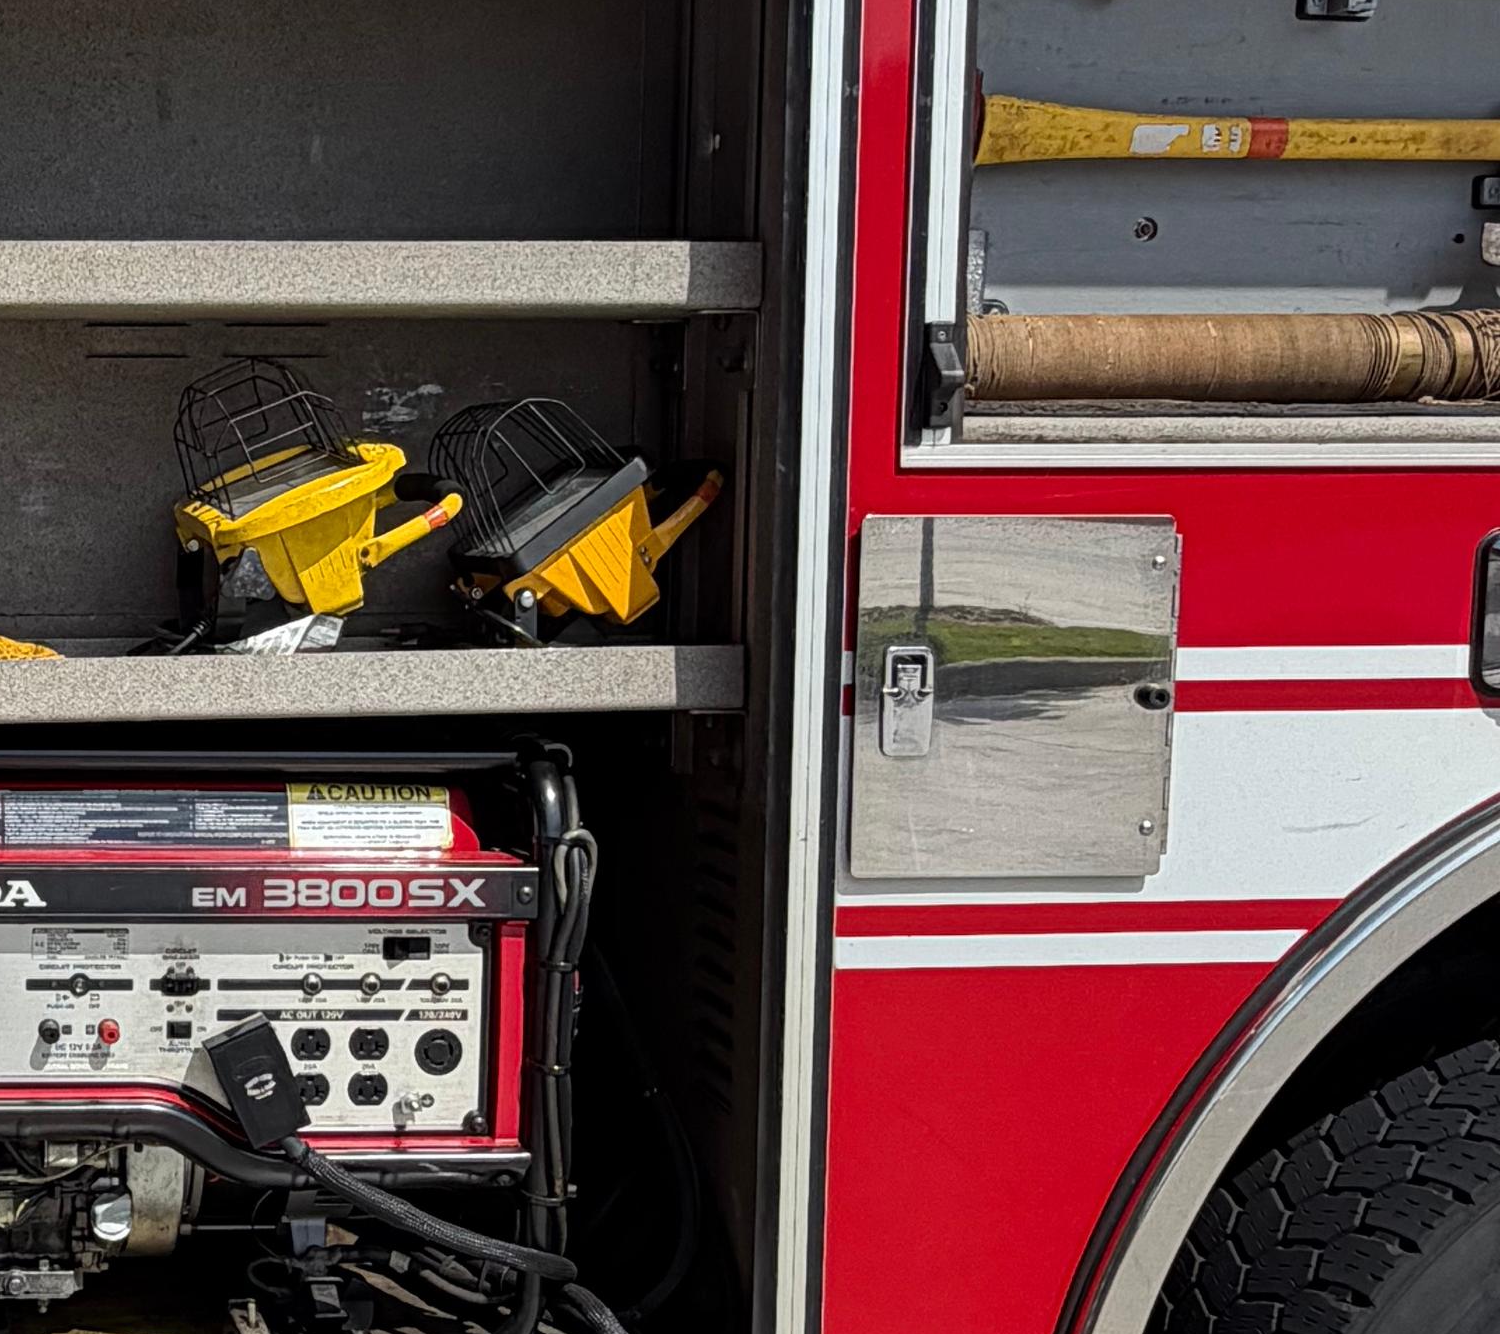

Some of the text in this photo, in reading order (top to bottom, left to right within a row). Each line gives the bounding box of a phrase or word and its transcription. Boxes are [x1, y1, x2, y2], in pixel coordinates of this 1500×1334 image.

[328, 784, 432, 801] CAUTION
[192, 878, 486, 908] EM 3800SX
[280, 1010, 294, 1020] AC
[296, 1010, 317, 1020] OUT
